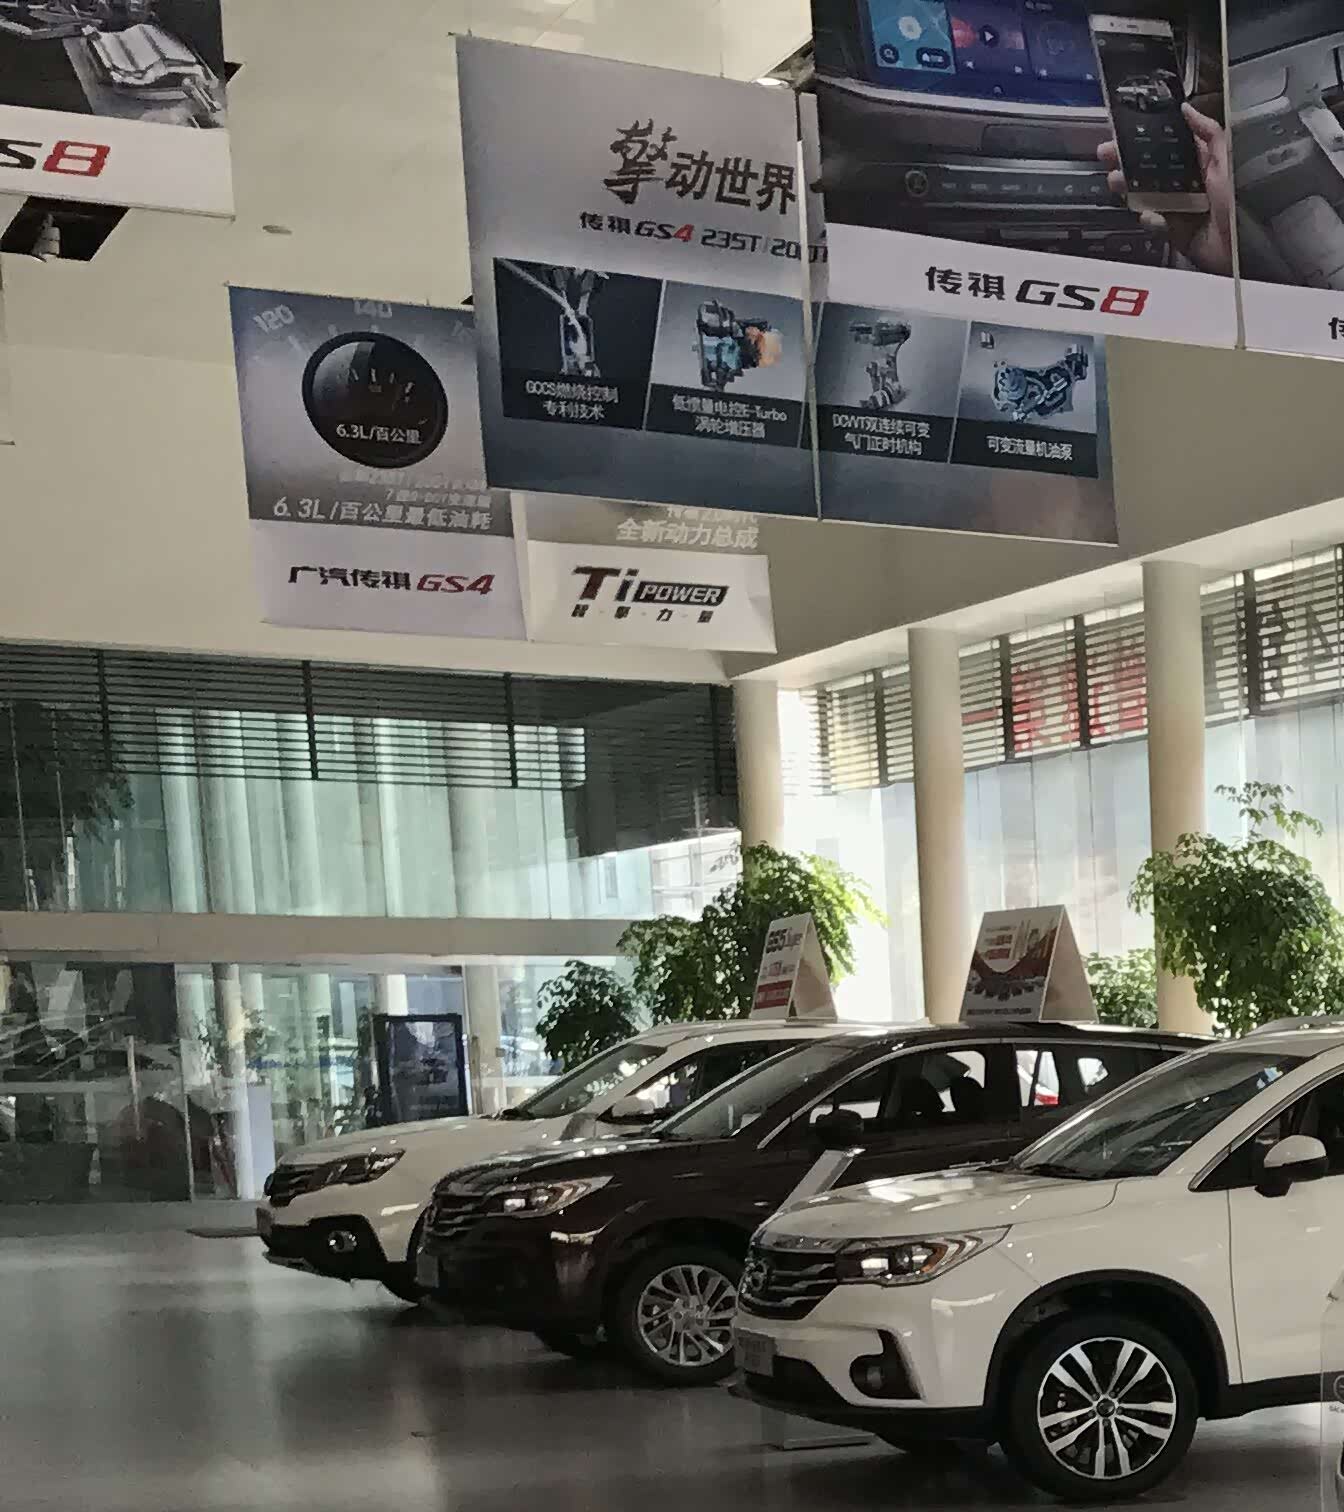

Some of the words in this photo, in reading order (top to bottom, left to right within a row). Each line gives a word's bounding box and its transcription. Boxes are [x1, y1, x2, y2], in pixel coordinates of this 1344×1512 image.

[253, 304, 296, 334] 120
[616, 517, 760, 549] 全新动力总成
